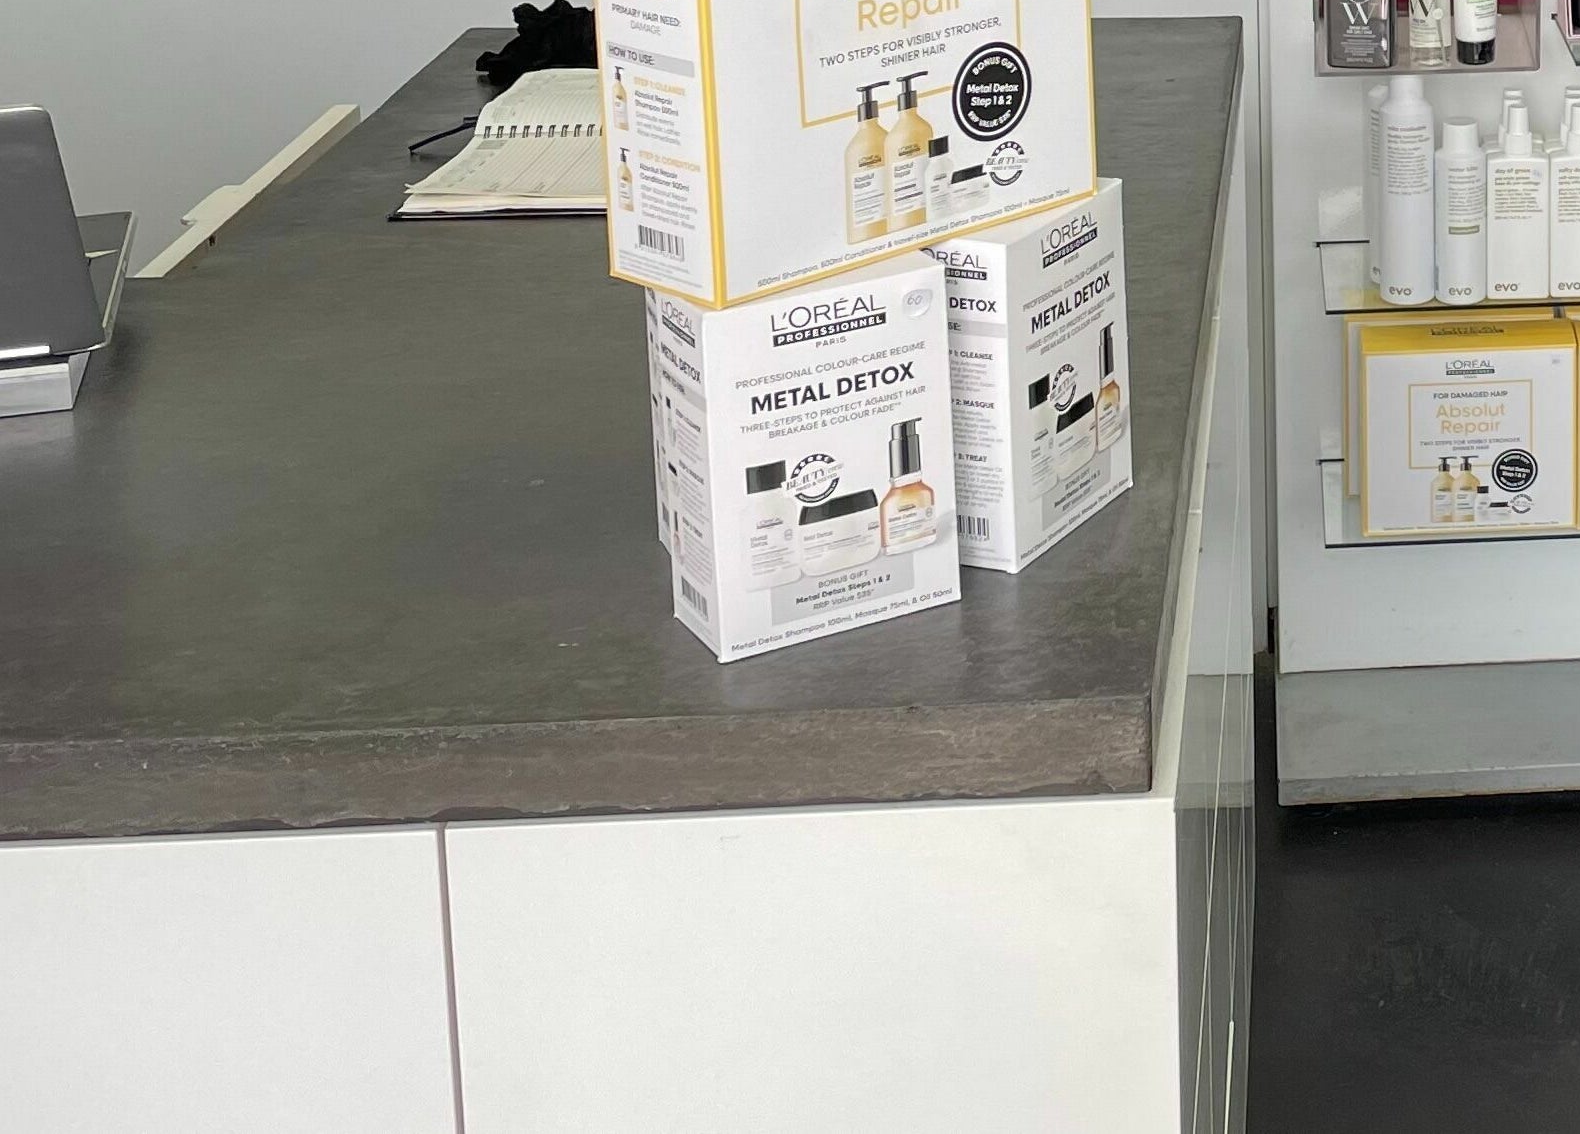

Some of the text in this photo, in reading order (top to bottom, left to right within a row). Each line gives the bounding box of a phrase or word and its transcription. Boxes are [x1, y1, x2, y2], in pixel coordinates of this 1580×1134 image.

[819, 16, 1002, 68] TWO STEPS FOR VISIBLY STRONGER,
[608, 45, 627, 58] HOW
[627, 50, 638, 61] TO
[880, 43, 947, 69] SHINIER HAIR
[966, 84, 1019, 94] Metal Detox
[971, 96, 992, 107] Step
[1005, 95, 1012, 105] 2
[1040, 211, 1098, 255] L'ORÉAL
[1388, 285, 1412, 297] evo
[1448, 285, 1472, 297] evo
[1494, 282, 1518, 292] evo
[950, 297, 997, 313] DETOX
[1031, 271, 1111, 334] METAL DETOX
[770, 294, 886, 333] L'ORÉAL
[776, 314, 884, 345] PROFESSIONNEL
[815, 336, 847, 348] PARIS
[736, 340, 926, 390] PROFESSIONAL COLOUR-CARE REGIME
[750, 385, 831, 414] METAL
[836, 361, 915, 396] DETOX
[740, 386, 926, 434] THREE-STEPS TO PROTECT AGAINST HAIR
[1435, 402, 1507, 419] Absolut
[768, 422, 819, 440] BREAKAGE
[820, 419, 828, 428] &
[830, 410, 870, 425] COLOUR
[1440, 419, 1502, 435] Repair
